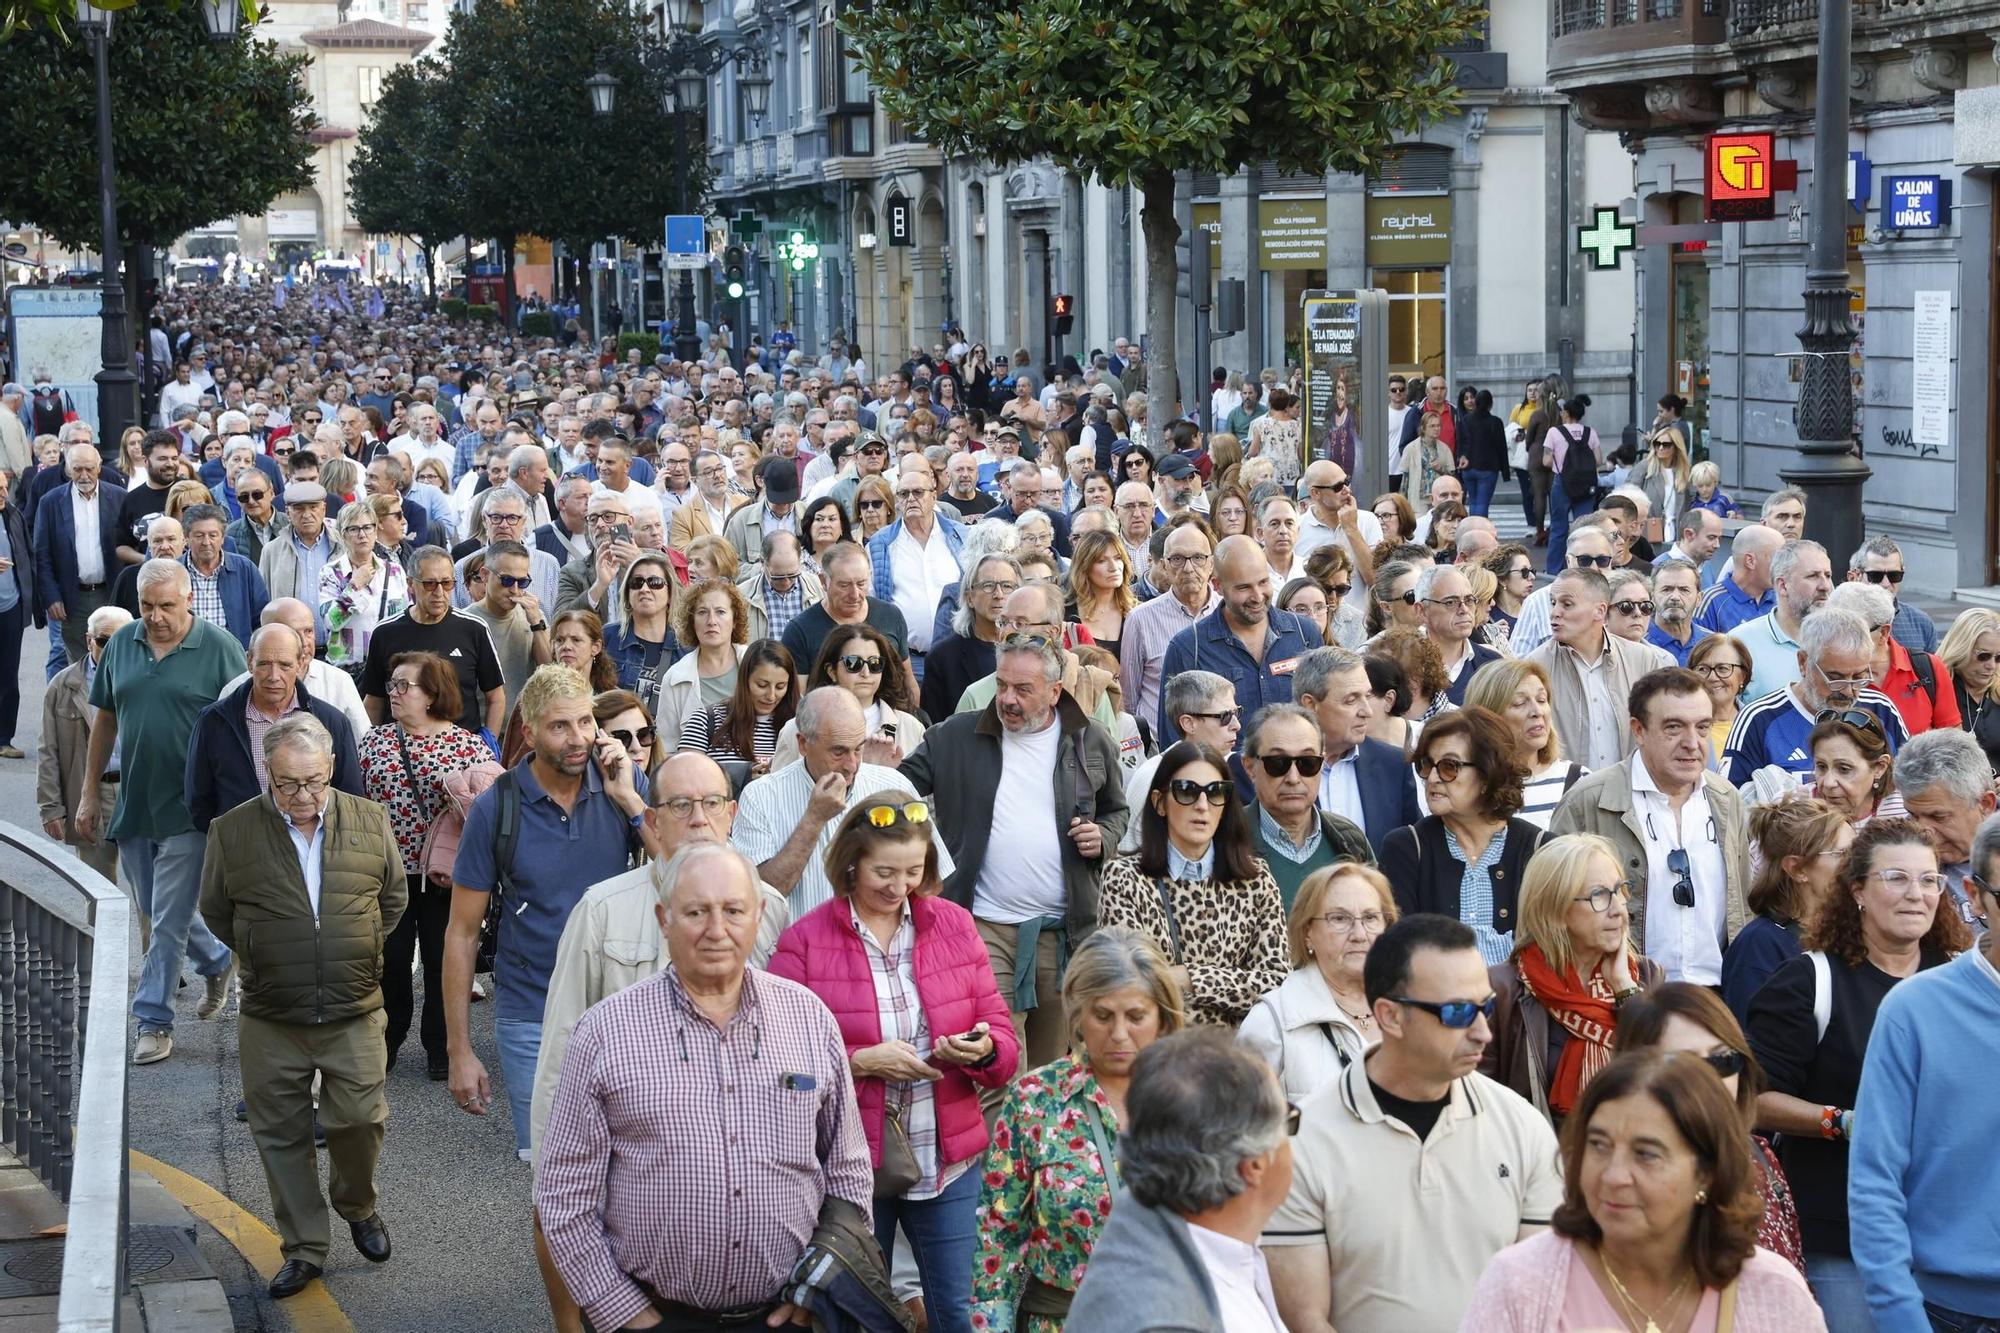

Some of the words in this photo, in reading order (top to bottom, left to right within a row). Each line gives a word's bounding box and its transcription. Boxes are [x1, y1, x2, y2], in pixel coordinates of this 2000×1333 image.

[1895, 180, 1933, 195] SALON
[1907, 196, 1921, 208] DE
[1381, 213, 1436, 230] reychel
[1895, 209, 1932, 226] UÑAS
[1312, 330, 1319, 340] ES
[1318, 329, 1326, 340] LA
[1326, 329, 1355, 340] TENACIDAD
[1314, 342, 1323, 353] DE
[1322, 340, 1339, 353] MARÍA
[1339, 340, 1353, 353] JOSÉ
